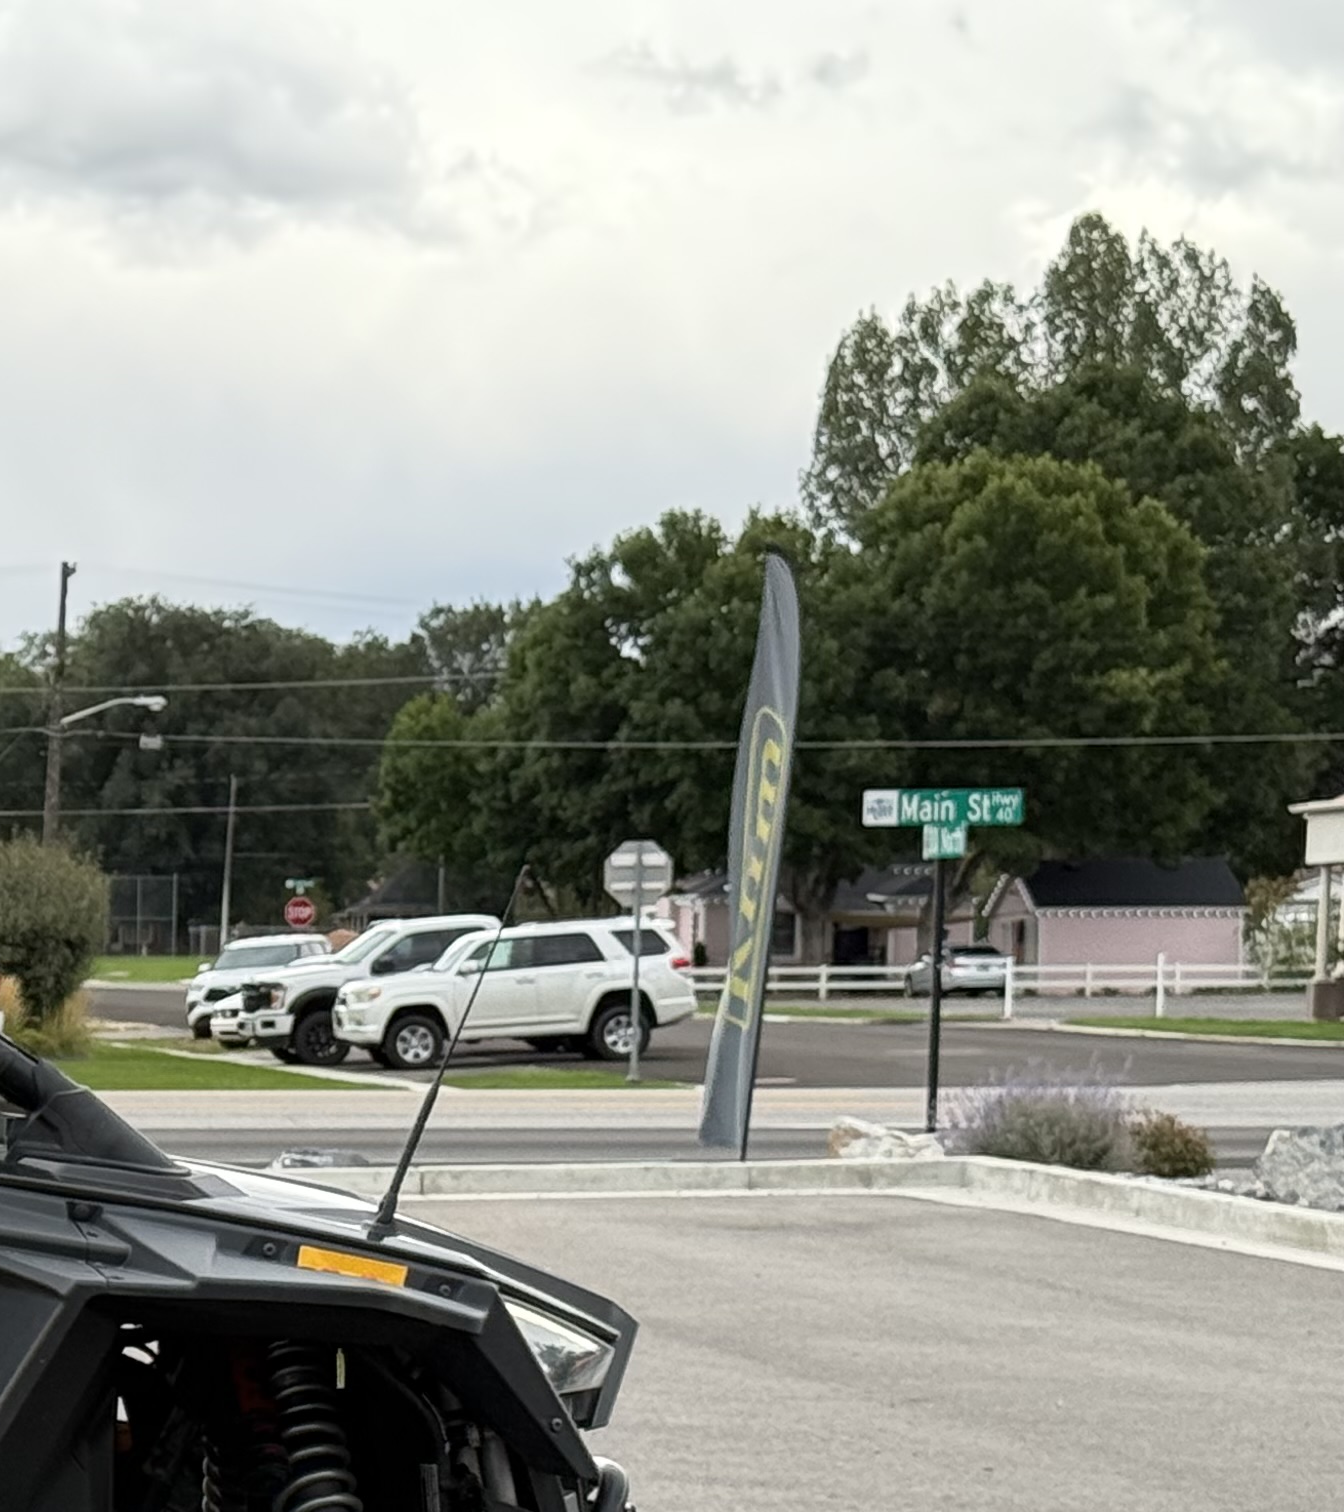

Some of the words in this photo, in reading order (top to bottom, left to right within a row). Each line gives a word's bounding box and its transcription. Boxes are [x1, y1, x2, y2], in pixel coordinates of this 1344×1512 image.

[900, 792, 956, 823] Main
[967, 793, 991, 823] St
[992, 792, 1020, 810] Hwy
[996, 808, 1013, 822] 40
[287, 906, 312, 920] STOP
